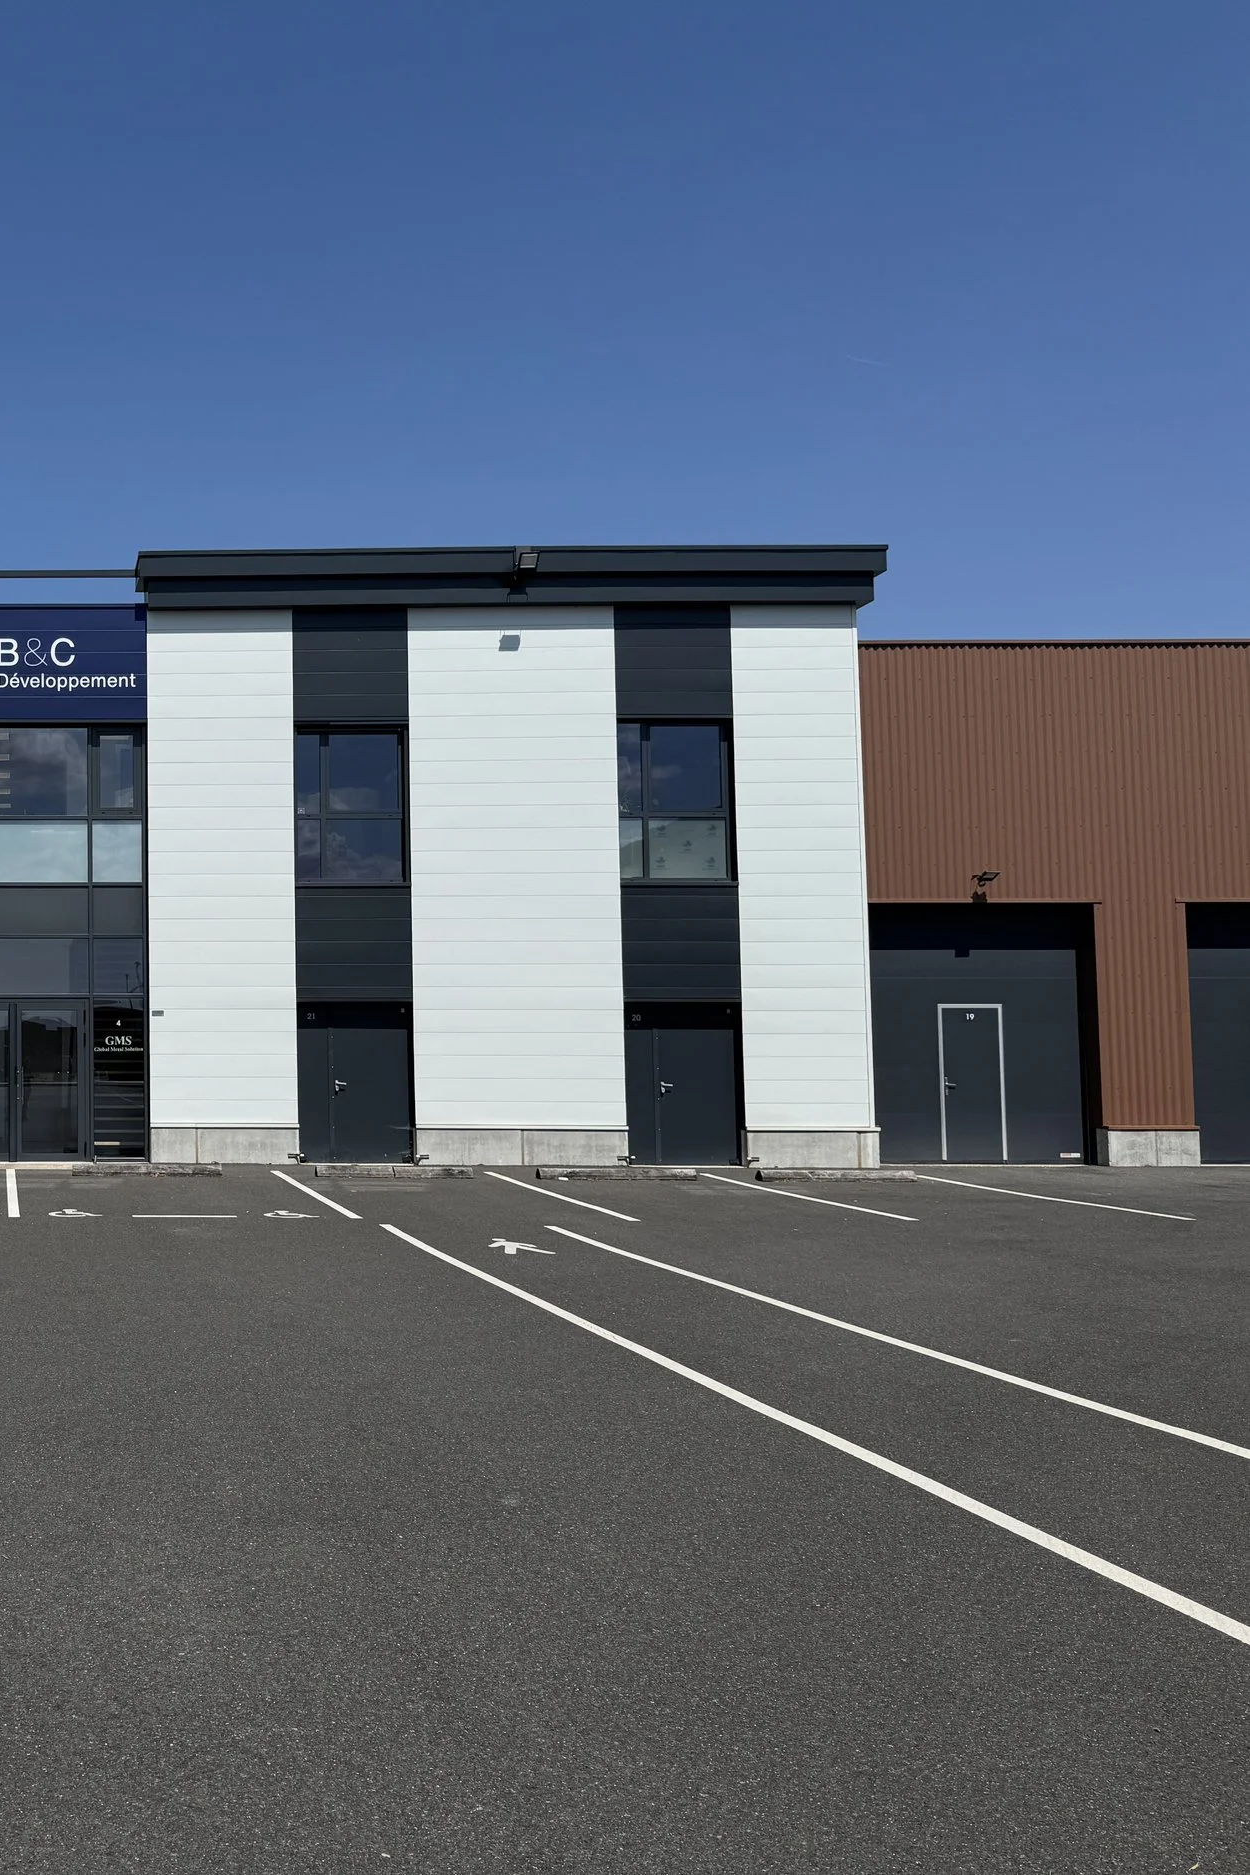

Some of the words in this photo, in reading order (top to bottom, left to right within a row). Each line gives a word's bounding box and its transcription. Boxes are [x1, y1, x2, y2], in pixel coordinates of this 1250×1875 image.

[306, 1012, 316, 1020] 21
[965, 1013, 975, 1021] 19
[105, 1035, 132, 1046] GMS
